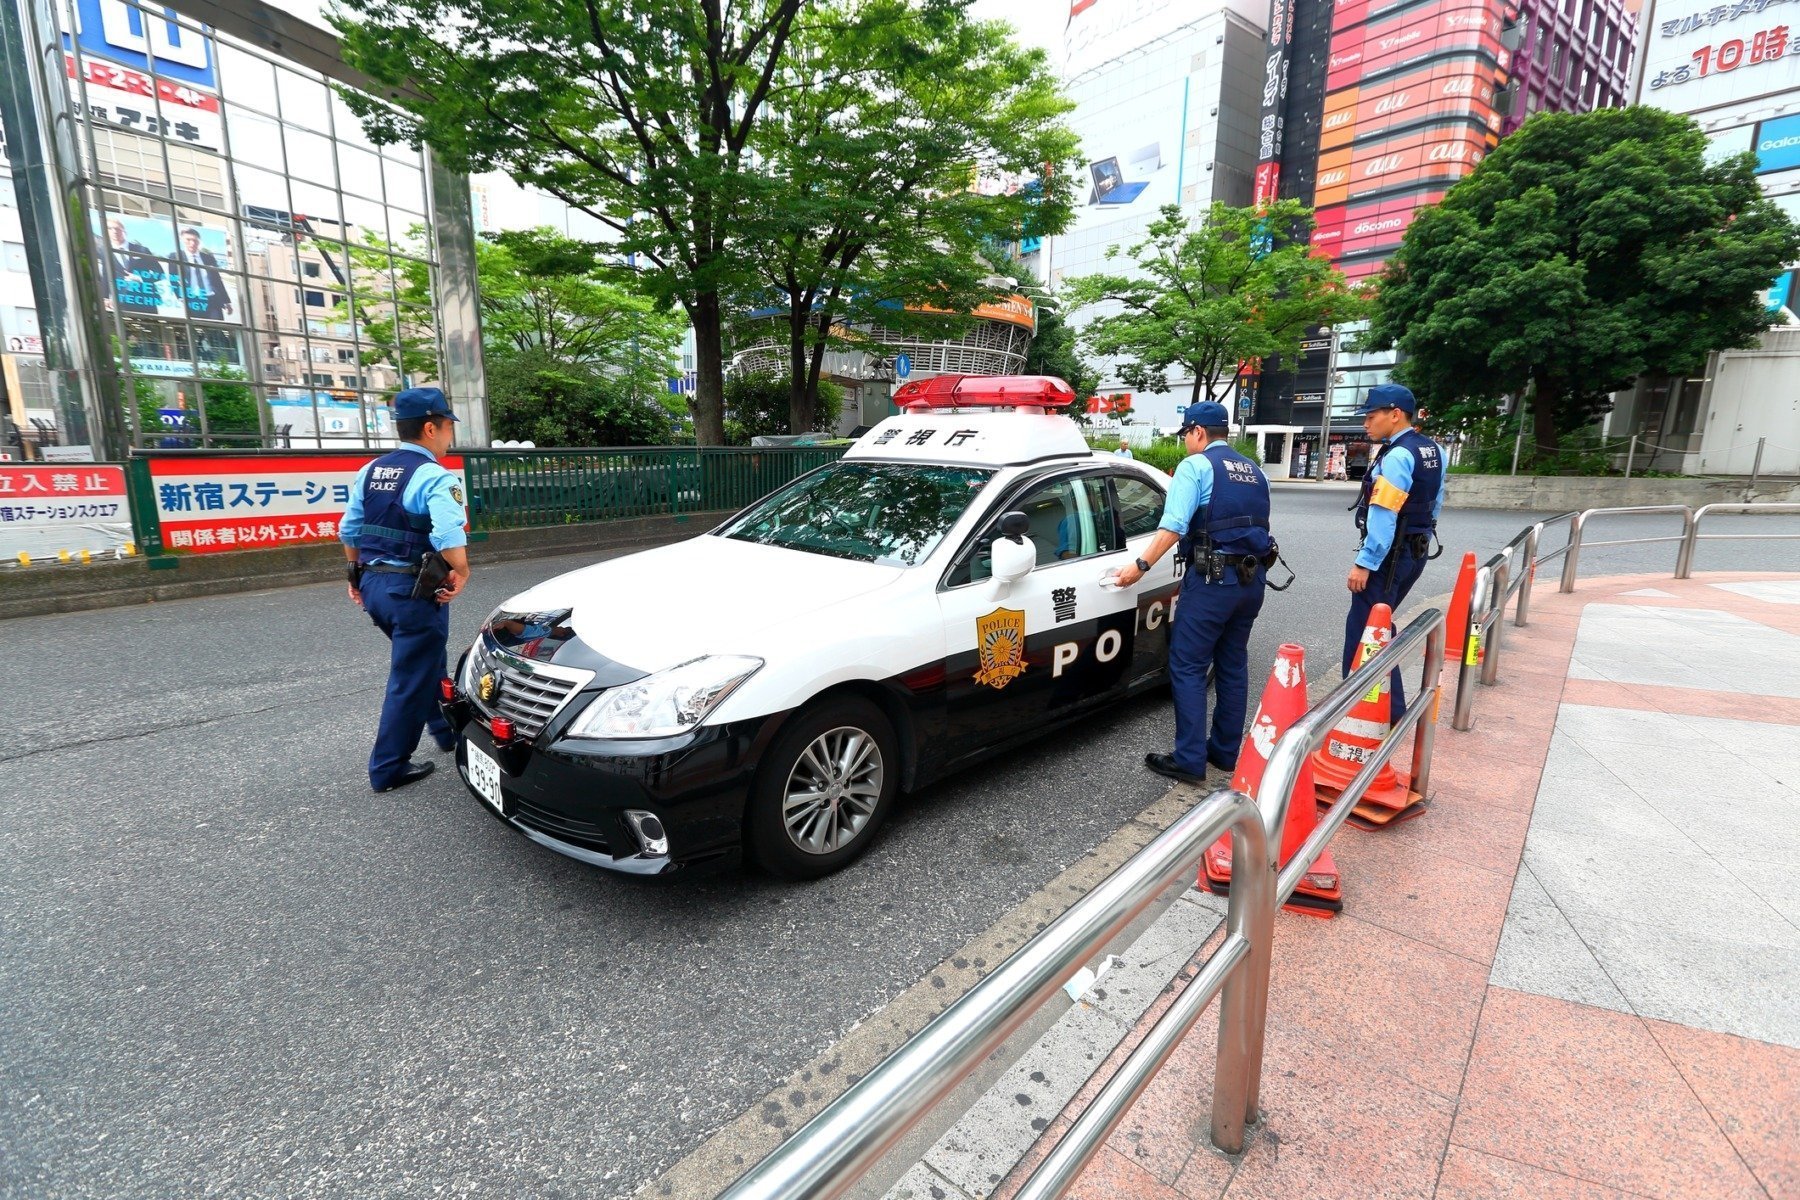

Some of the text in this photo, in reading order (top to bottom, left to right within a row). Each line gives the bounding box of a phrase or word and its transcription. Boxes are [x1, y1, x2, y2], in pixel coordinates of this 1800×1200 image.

[1443, 79, 1474, 95] au
[1375, 93, 1410, 115] au
[1325, 111, 1352, 129] au
[1429, 143, 1467, 160] au
[1364, 153, 1404, 176] au
[1319, 170, 1346, 186] au
[1354, 217, 1402, 235] docomo
[1313, 230, 1342, 242] docomo
[873, 428, 979, 446] 警視庁
[371, 466, 405, 480] 警視庁
[1223, 460, 1253, 474] 警視庁
[0, 473, 110, 492] 立入禁止
[368, 481, 398, 491] POLICE
[1229, 473, 1258, 484] POLICE
[1052, 586, 1077, 623] 警
[982, 618, 1020, 633] POLICE
